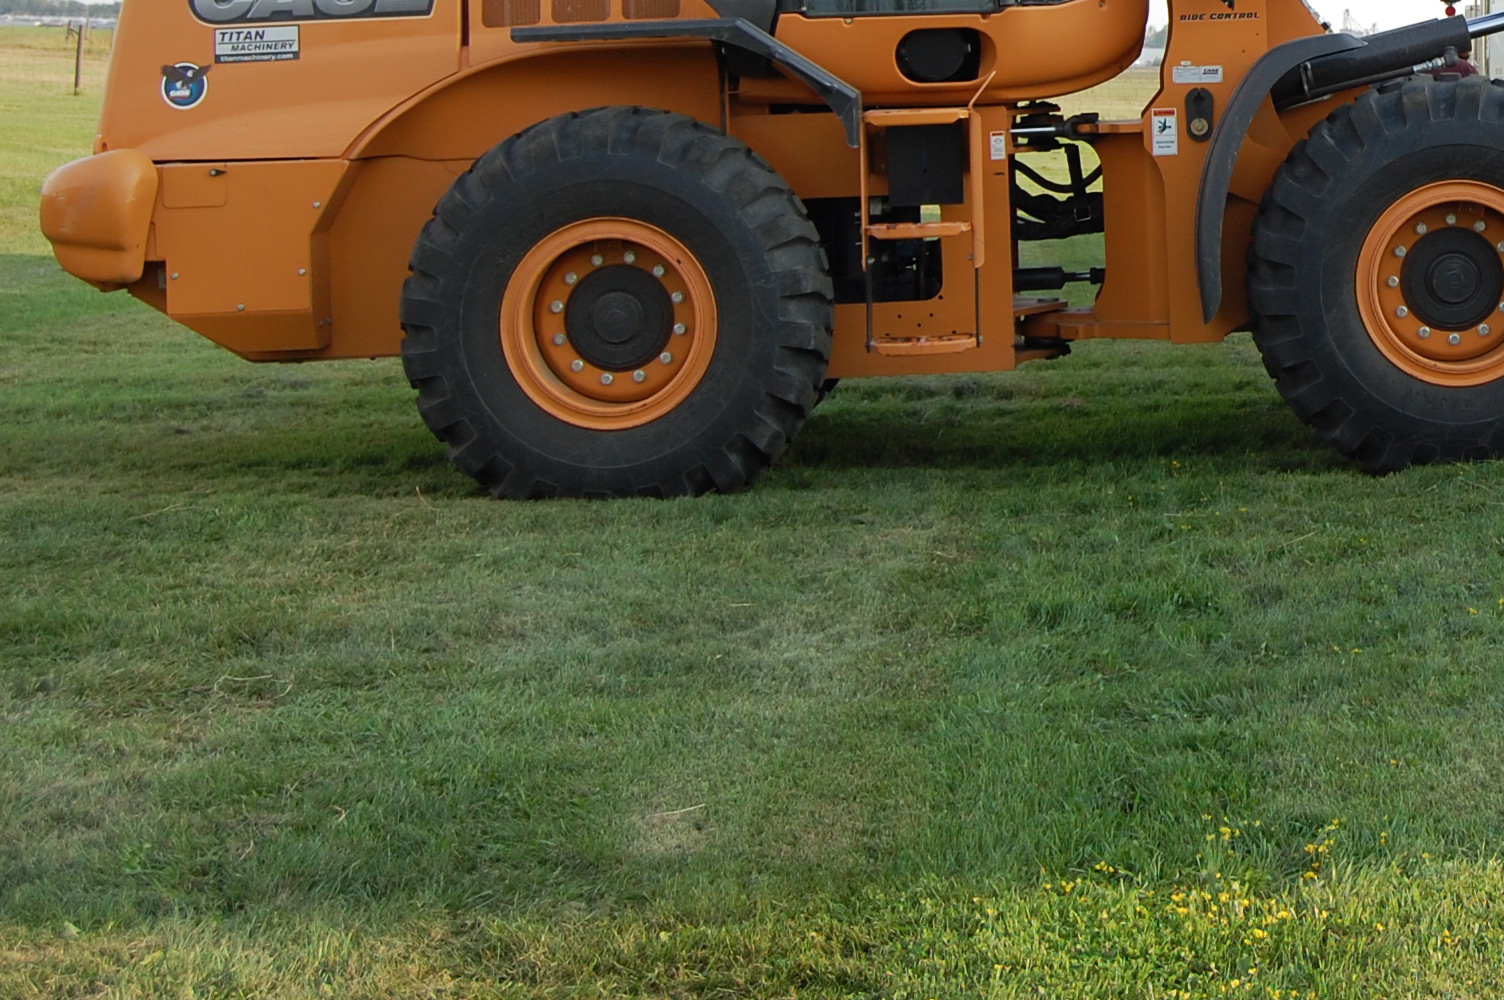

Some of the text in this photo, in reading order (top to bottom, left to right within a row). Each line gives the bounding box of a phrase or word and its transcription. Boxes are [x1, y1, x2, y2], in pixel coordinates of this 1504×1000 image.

[1180, 11, 1260, 21] RIDE CONTROL
[219, 30, 266, 42] TITAN
[231, 42, 294, 52] MACHINERY
